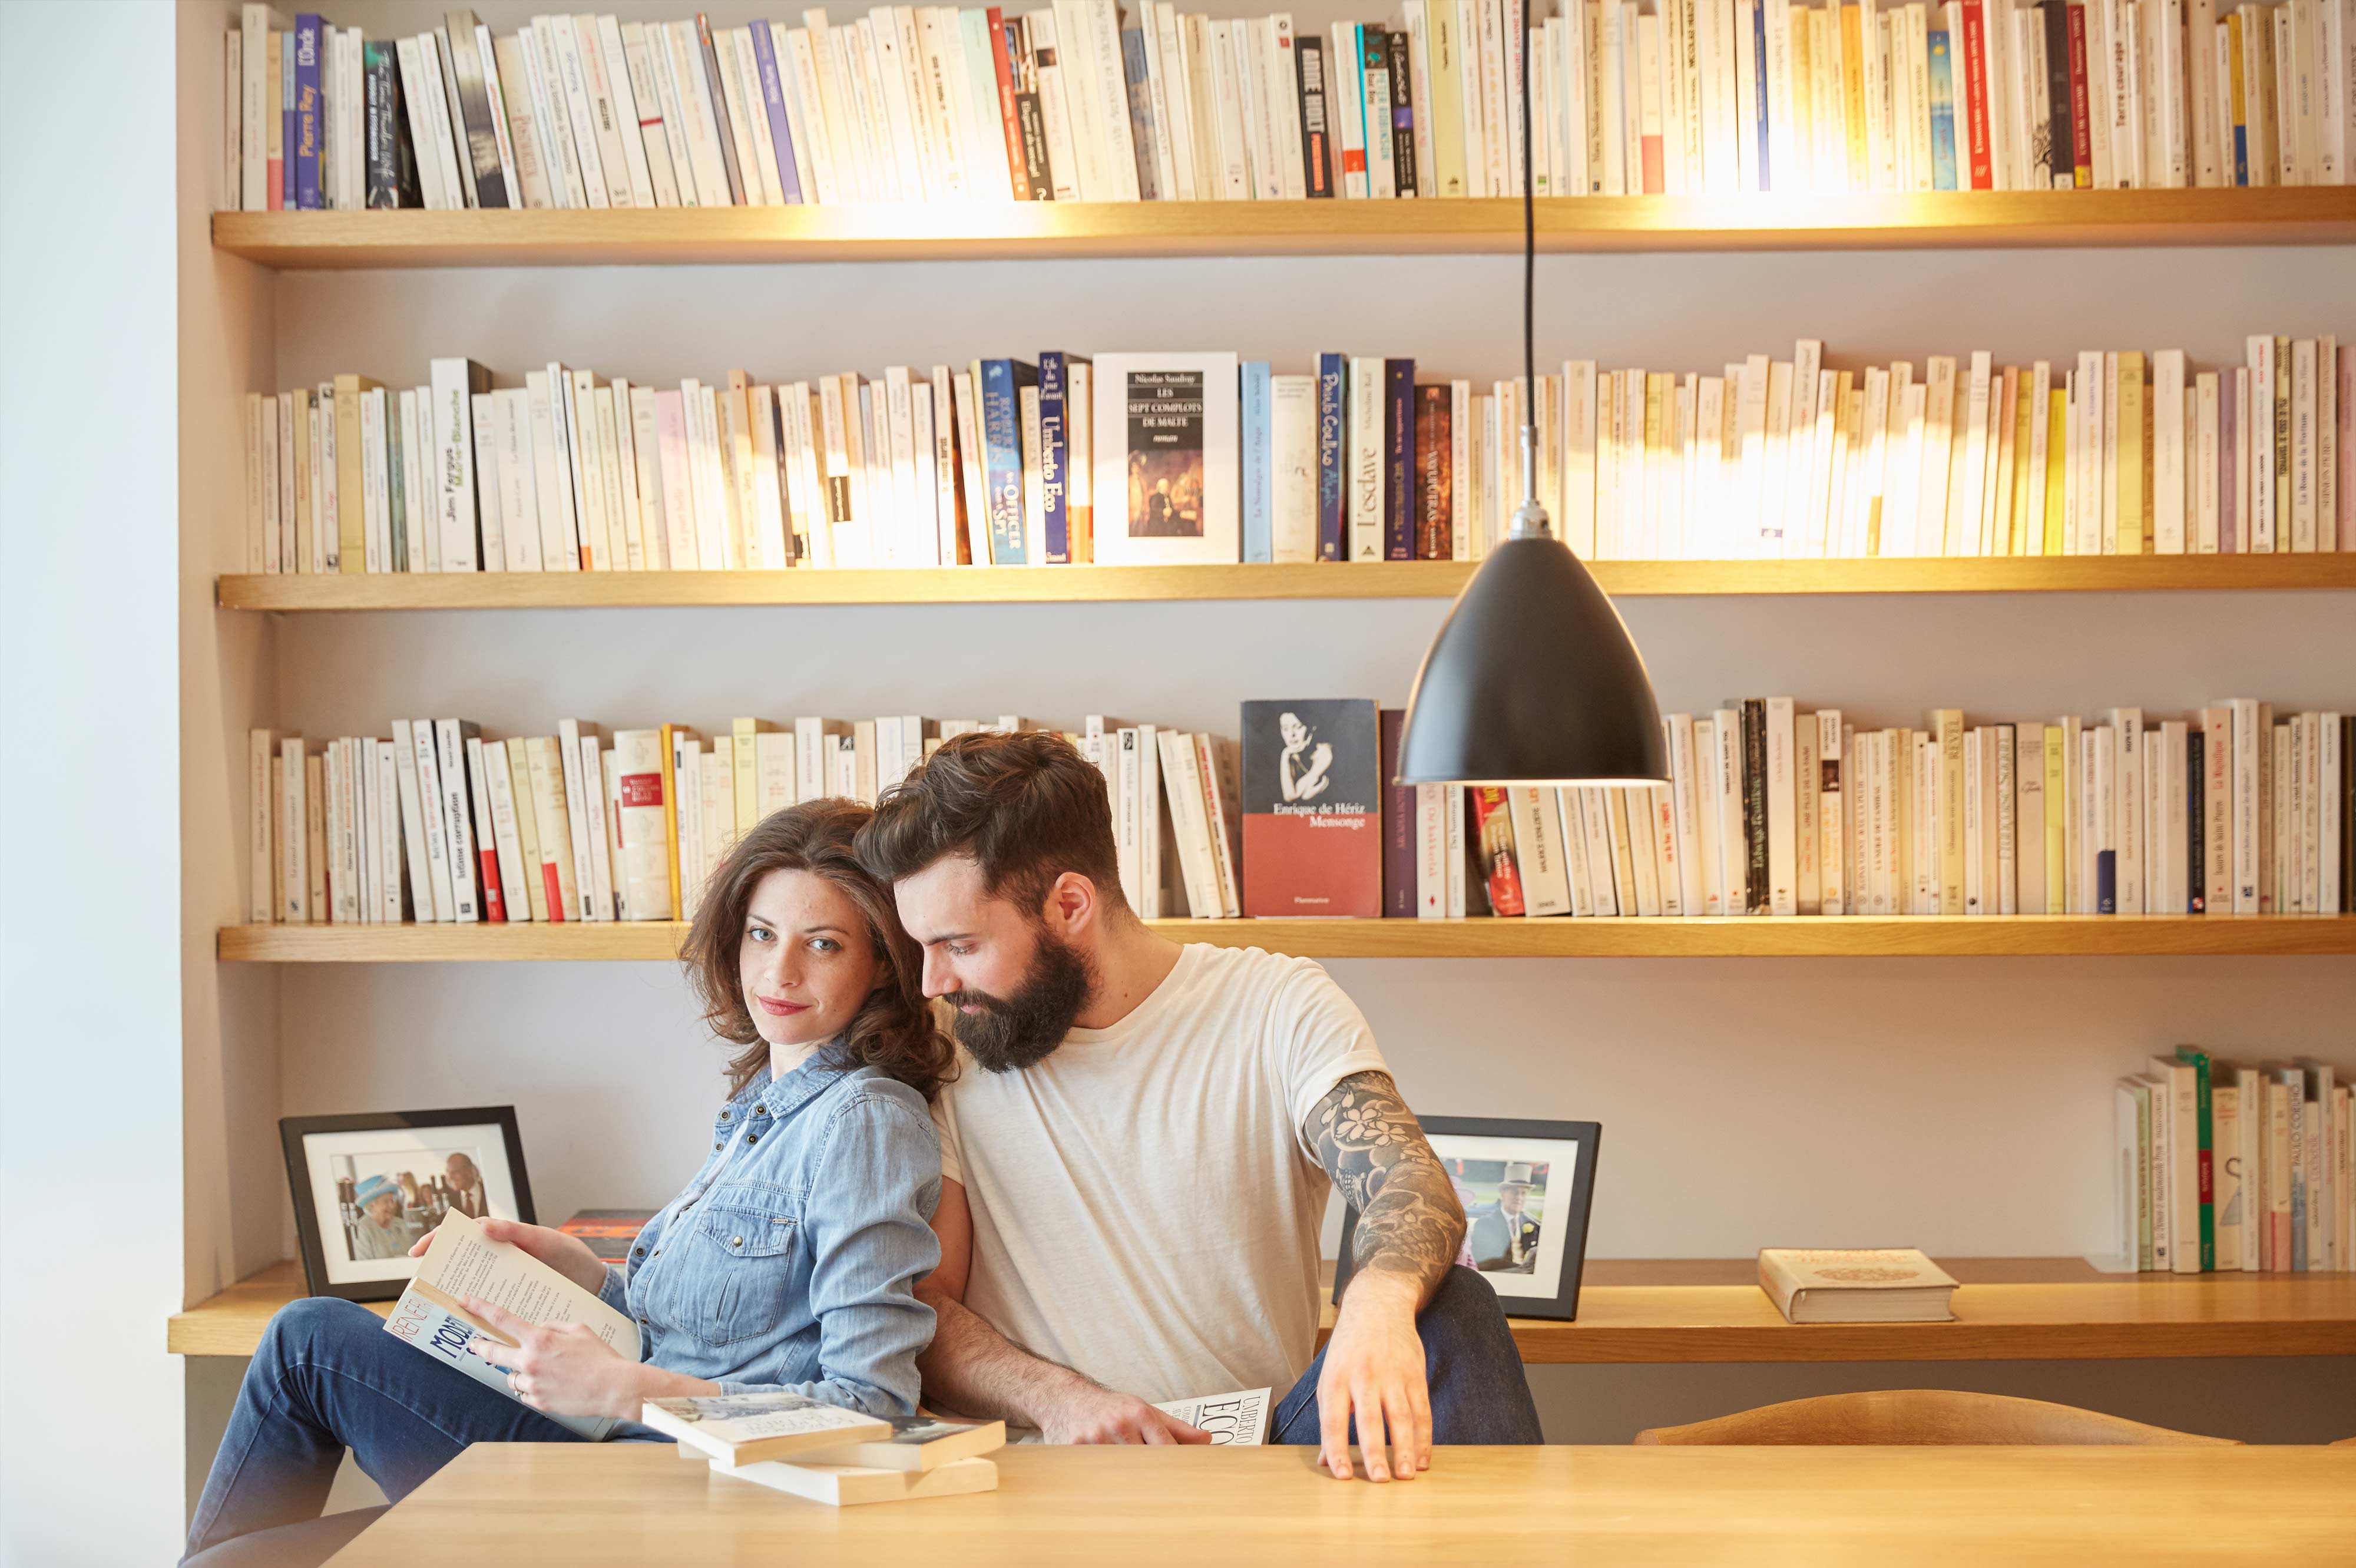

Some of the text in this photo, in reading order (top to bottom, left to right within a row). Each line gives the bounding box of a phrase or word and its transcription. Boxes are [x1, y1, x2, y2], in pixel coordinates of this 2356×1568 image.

[1301, 49, 1325, 133] ANNE HOLT
[1366, 72, 1375, 87] Bad
[2115, 41, 2126, 128] Terre courage
[299, 85, 316, 157] Pierre Rey
[1376, 72, 1391, 161] PETER ROBINSON
[1134, 373, 1163, 384] Nicolas
[1157, 388, 1174, 398] LES
[1321, 372, 1339, 413] Paulo
[985, 392, 1015, 463] ROBERT HARRIS
[1129, 403, 1203, 413] SEPT COMPLOTS
[1143, 417, 1189, 428] DE MALTE
[451, 389, 464, 487] Marie-Blanche
[1321, 414, 1339, 466] Coelho
[1041, 415, 1064, 512] Umberto Eco
[444, 448, 456, 522] Jim Fergus
[1253, 468, 1263, 506] Nostalgie
[1356, 448, 1377, 527] L'esclave
[992, 510, 1008, 537] SPY
[1003, 484, 1021, 550] OFFICER
[1947, 717, 1960, 760] REVEL
[2213, 781, 2223, 790] La
[1273, 801, 1366, 817] Enrique de Hériz
[1310, 816, 1366, 829] Mensonge
[2214, 800, 2223, 822] Pierre
[1751, 828, 1765, 868] Edwige
[2214, 825, 2223, 842] Saint
[453, 848, 466, 879] Intime
[2290, 1084, 2301, 1167] PAULO COELHO
[391, 1304, 426, 1342] IRENE
[1198, 1398, 1242, 1445] ECO
[1235, 1395, 1261, 1444] UMBERTO
